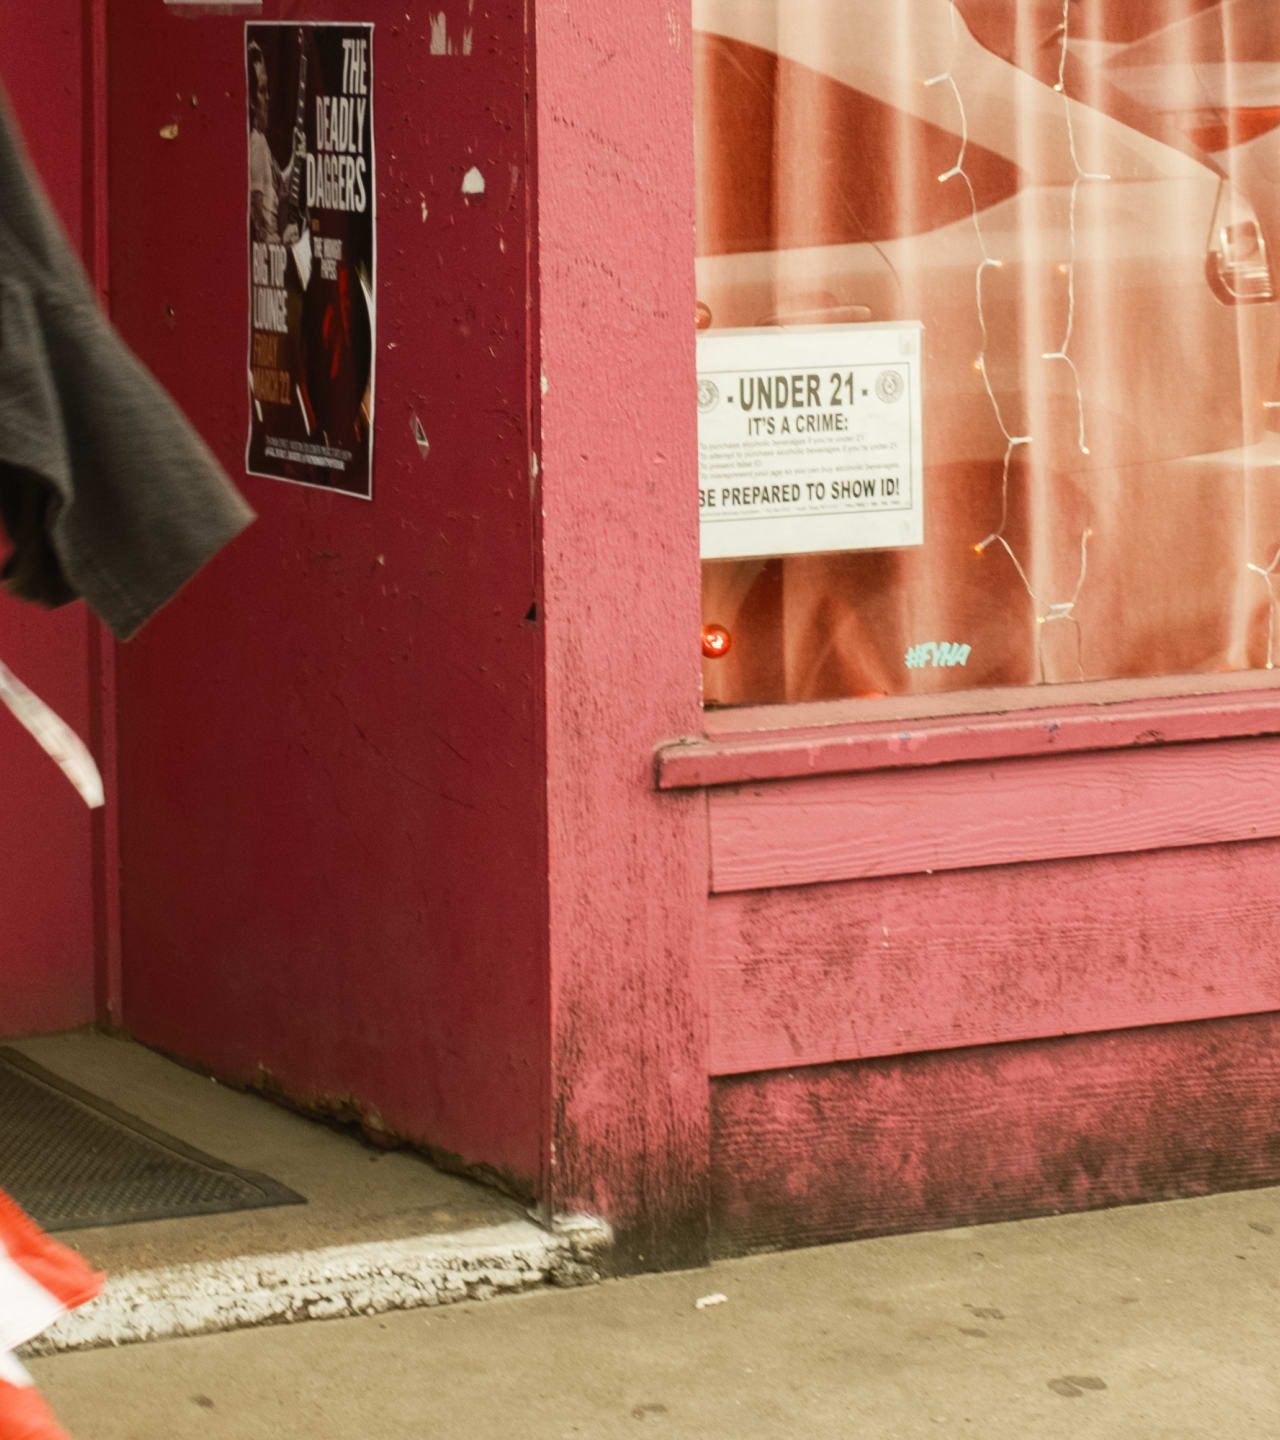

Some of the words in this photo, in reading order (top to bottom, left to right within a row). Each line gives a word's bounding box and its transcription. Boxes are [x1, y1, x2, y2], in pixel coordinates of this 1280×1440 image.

[341, 38, 368, 95] THE
[315, 95, 367, 153] DEADLY
[306, 153, 367, 213] DAGGERS
[253, 286, 289, 334] LOUNGE
[739, 373, 821, 411] UNDER
[829, 371, 854, 406] 21
[748, 416, 775, 436] IT'S
[780, 415, 791, 435] A
[795, 413, 848, 433] CRIME:
[722, 483, 801, 507] PREPARED
[806, 481, 826, 502] TO
[831, 478, 876, 500] SHOW
[881, 476, 900, 497] ID!
